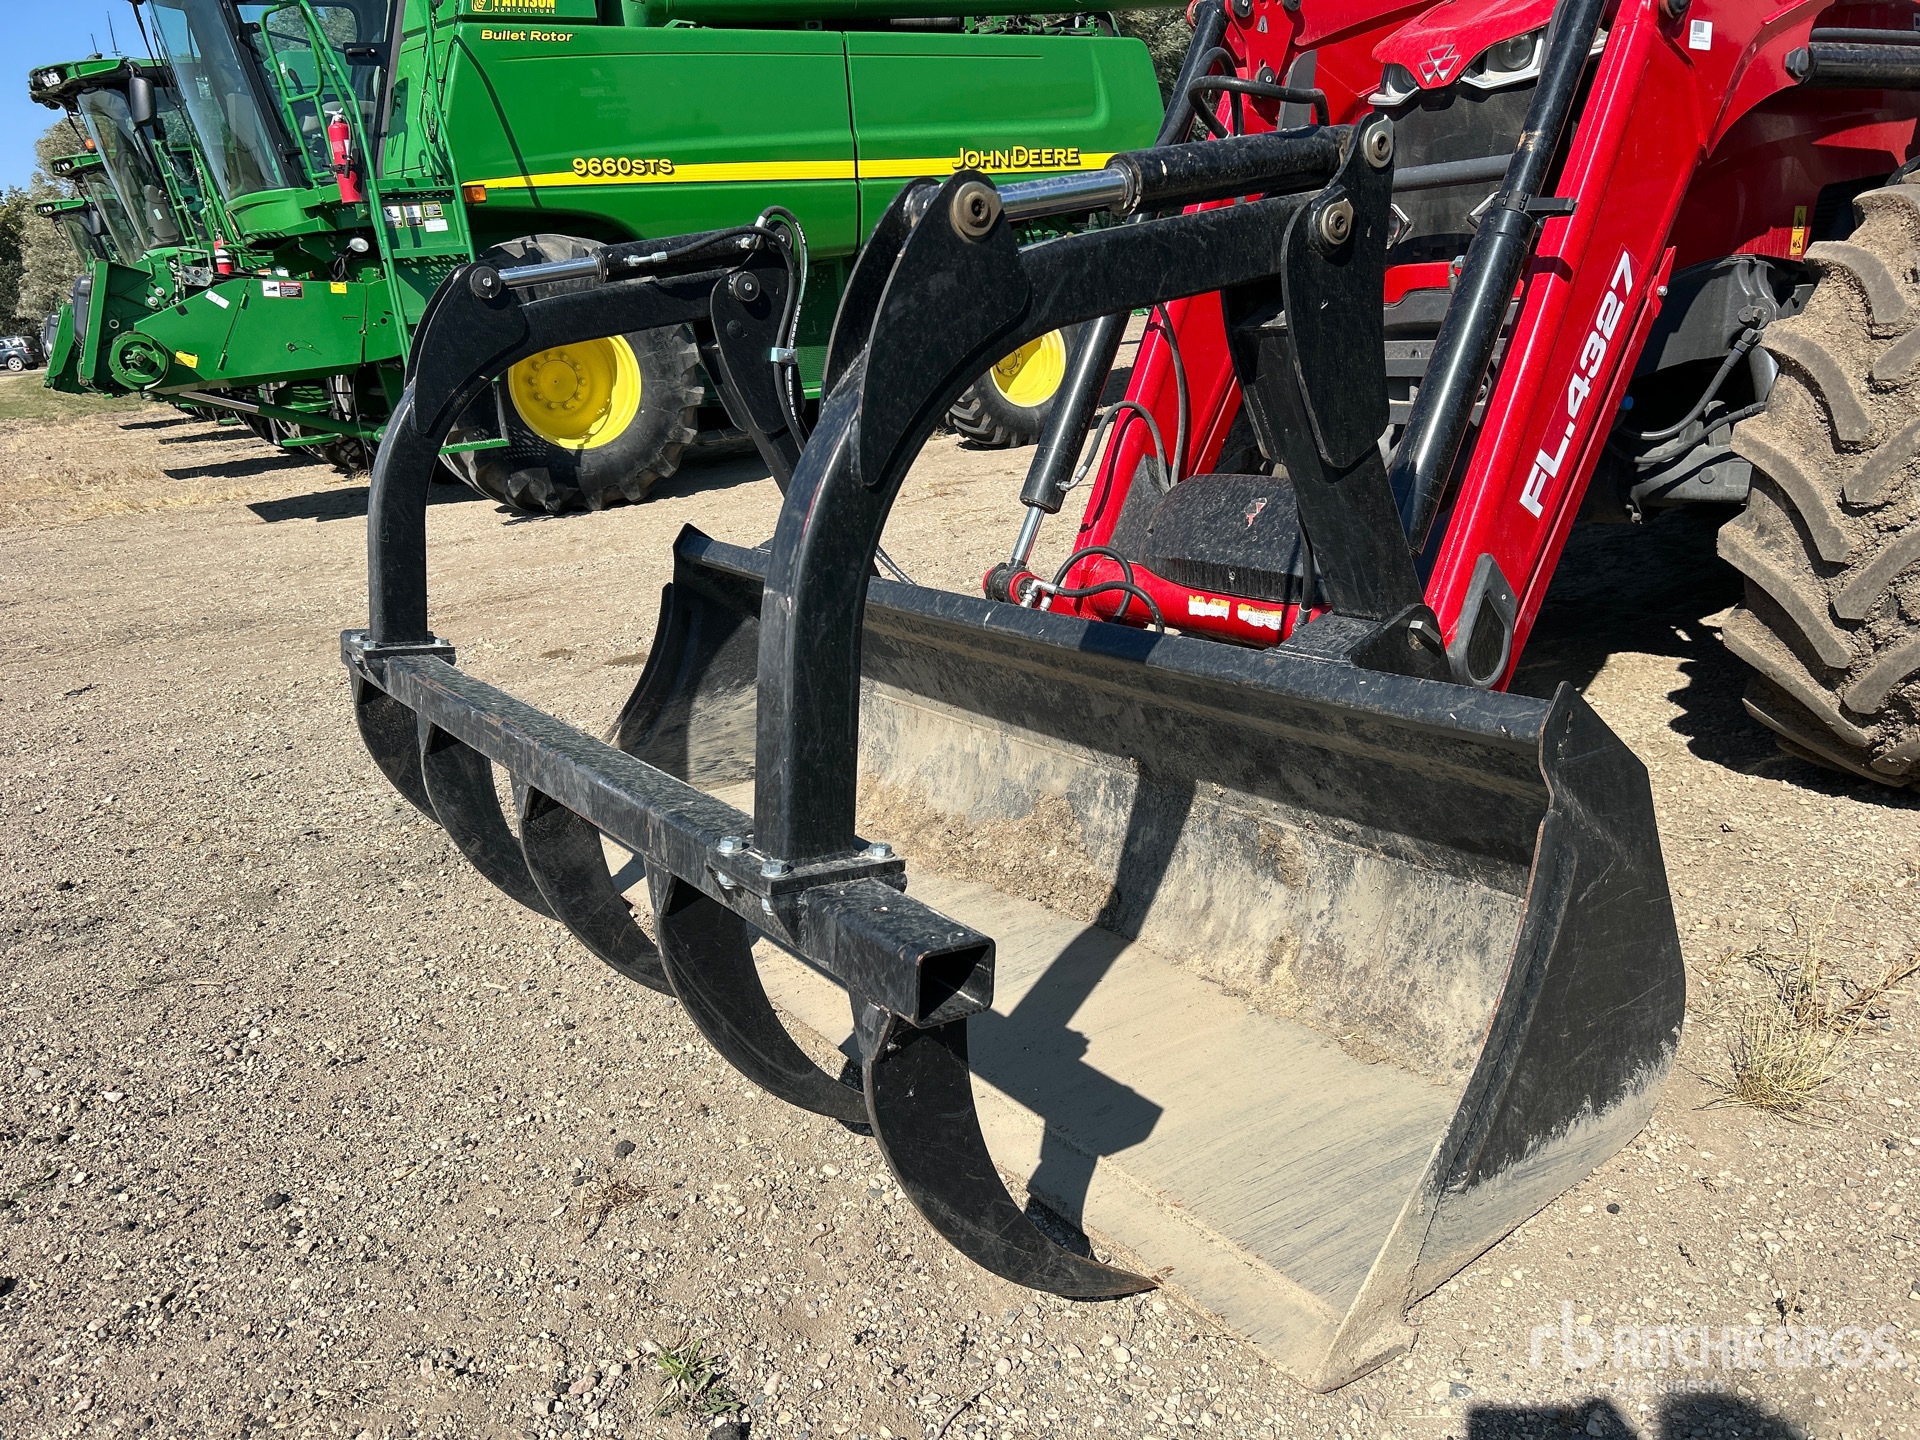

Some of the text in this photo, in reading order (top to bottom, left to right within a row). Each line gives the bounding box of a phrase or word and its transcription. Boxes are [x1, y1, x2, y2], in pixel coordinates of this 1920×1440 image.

[481, 29, 574, 42] Bullet Rotor
[572, 157, 675, 177] 9660STS
[952, 145, 1080, 169] JOHN DEERE
[1519, 250, 1633, 518] FL.4327
